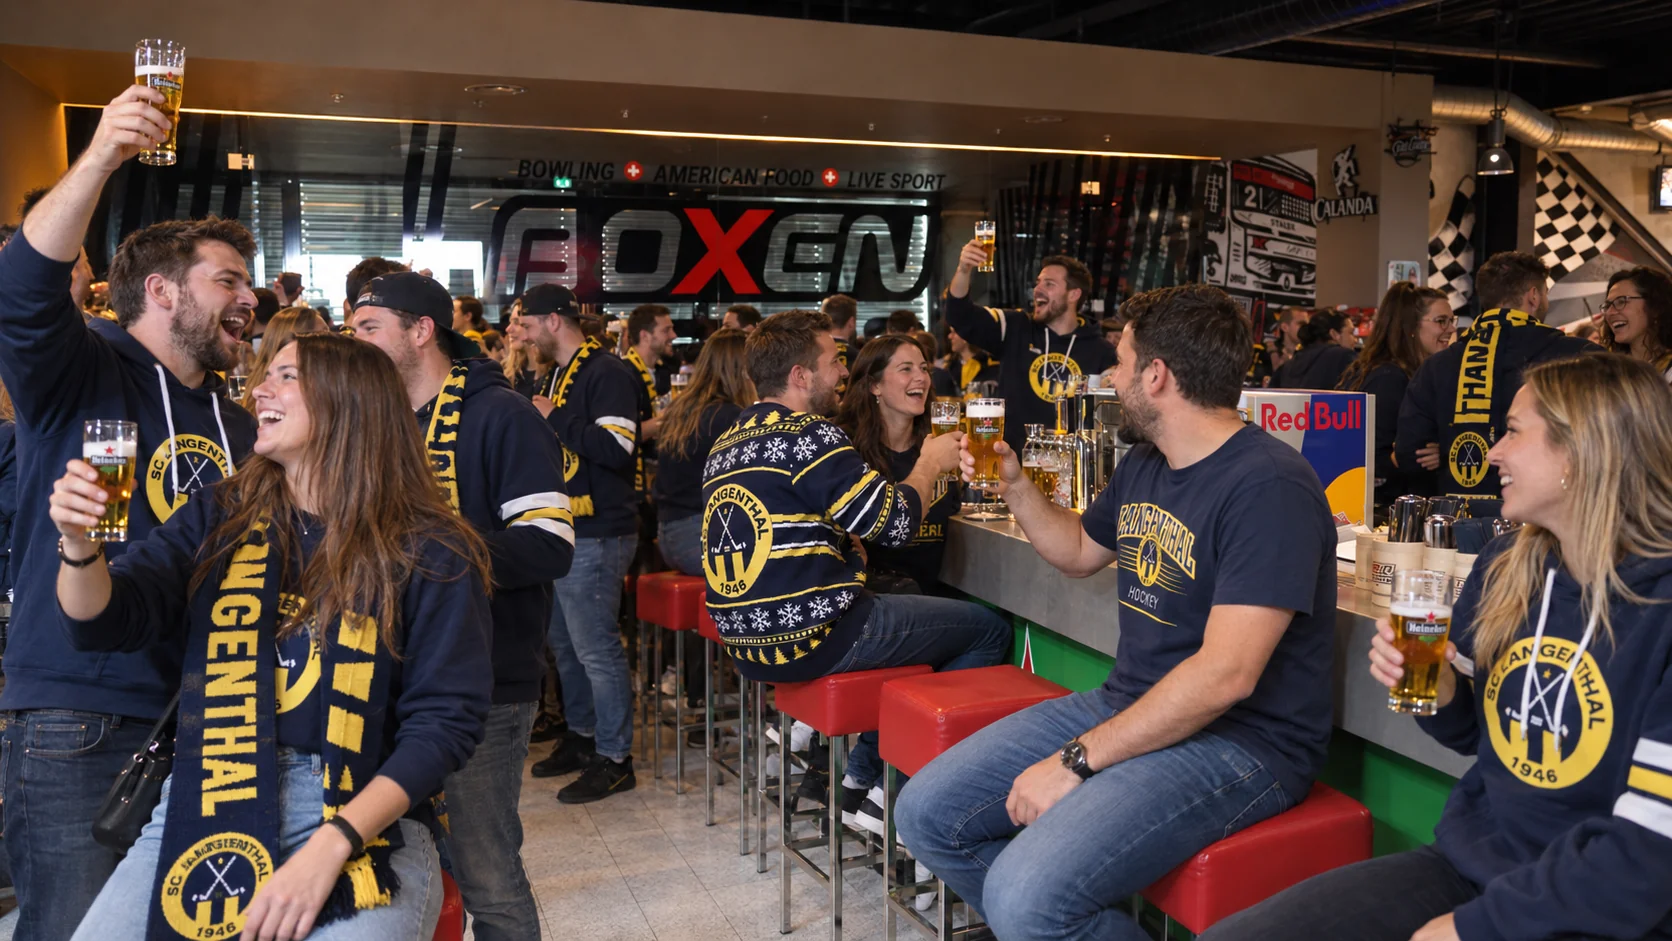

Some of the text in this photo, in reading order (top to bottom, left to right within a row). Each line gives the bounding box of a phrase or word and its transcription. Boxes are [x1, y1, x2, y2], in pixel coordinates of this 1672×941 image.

[517, 159, 946, 190] BOWLING AMERICAN FOOD LIVE SPORT
[1315, 197, 1374, 221] CALANDA
[1261, 400, 1361, 432] Red Bull
[151, 459, 165, 481] SC
[719, 580, 747, 595] 1946
[1127, 585, 1160, 610] HOCKEY
[201, 516, 269, 818] NGENTHAL
[1487, 674, 1501, 701] SC
[1510, 756, 1558, 783] 1946
[167, 875, 183, 897] SC
[196, 921, 236, 939] 1946
